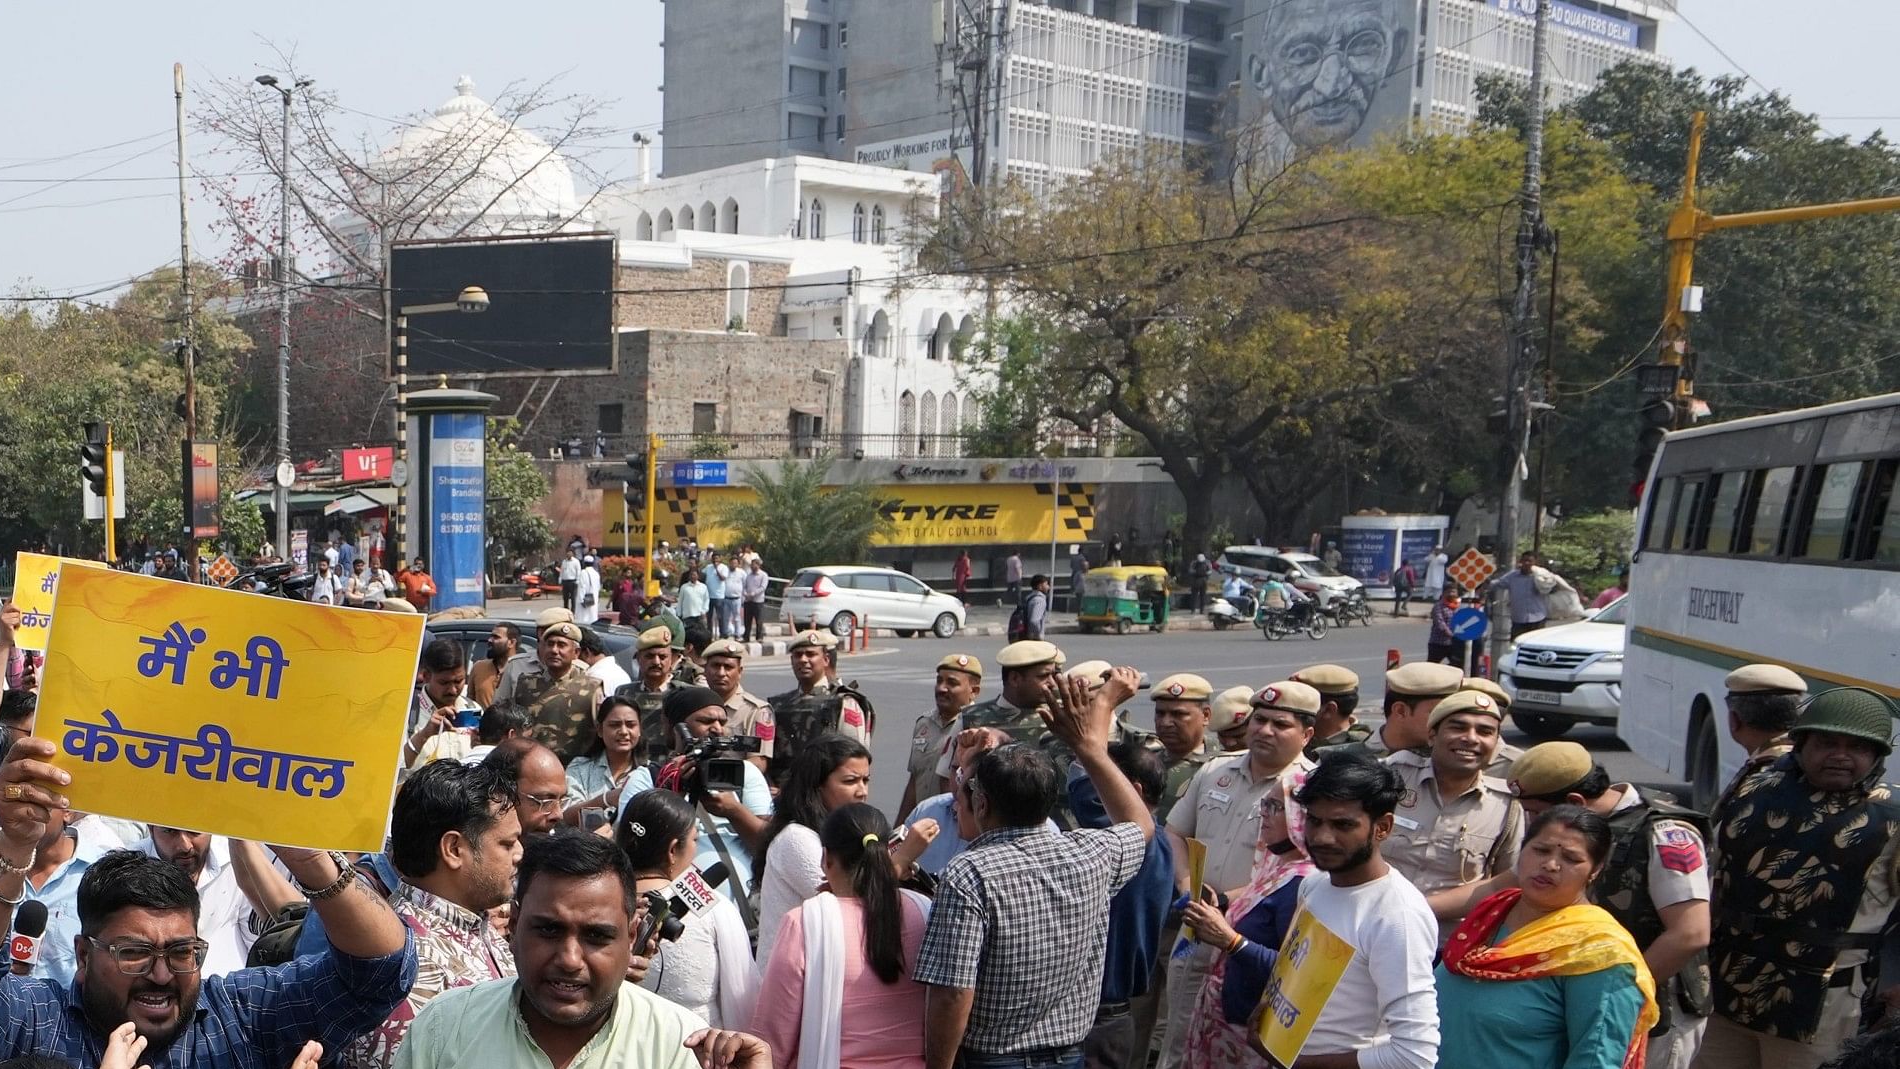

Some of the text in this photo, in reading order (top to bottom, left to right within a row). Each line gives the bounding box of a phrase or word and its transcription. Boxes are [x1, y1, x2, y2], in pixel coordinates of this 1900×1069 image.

[1563, 7, 1607, 32] QUARTERS
[1607, 22, 1632, 43] DELHI
[856, 149, 893, 164] PROUDLY
[892, 142, 930, 160] WORKING
[931, 138, 948, 151] FOR
[906, 526, 998, 538] TOTAL CONTROL
[41, 571, 58, 595] मैं
[1687, 586, 1745, 625] HIGHWAY
[137, 621, 289, 700] मैं भी
[62, 709, 354, 800] केजरीवाल
[674, 880, 705, 912] भारत
